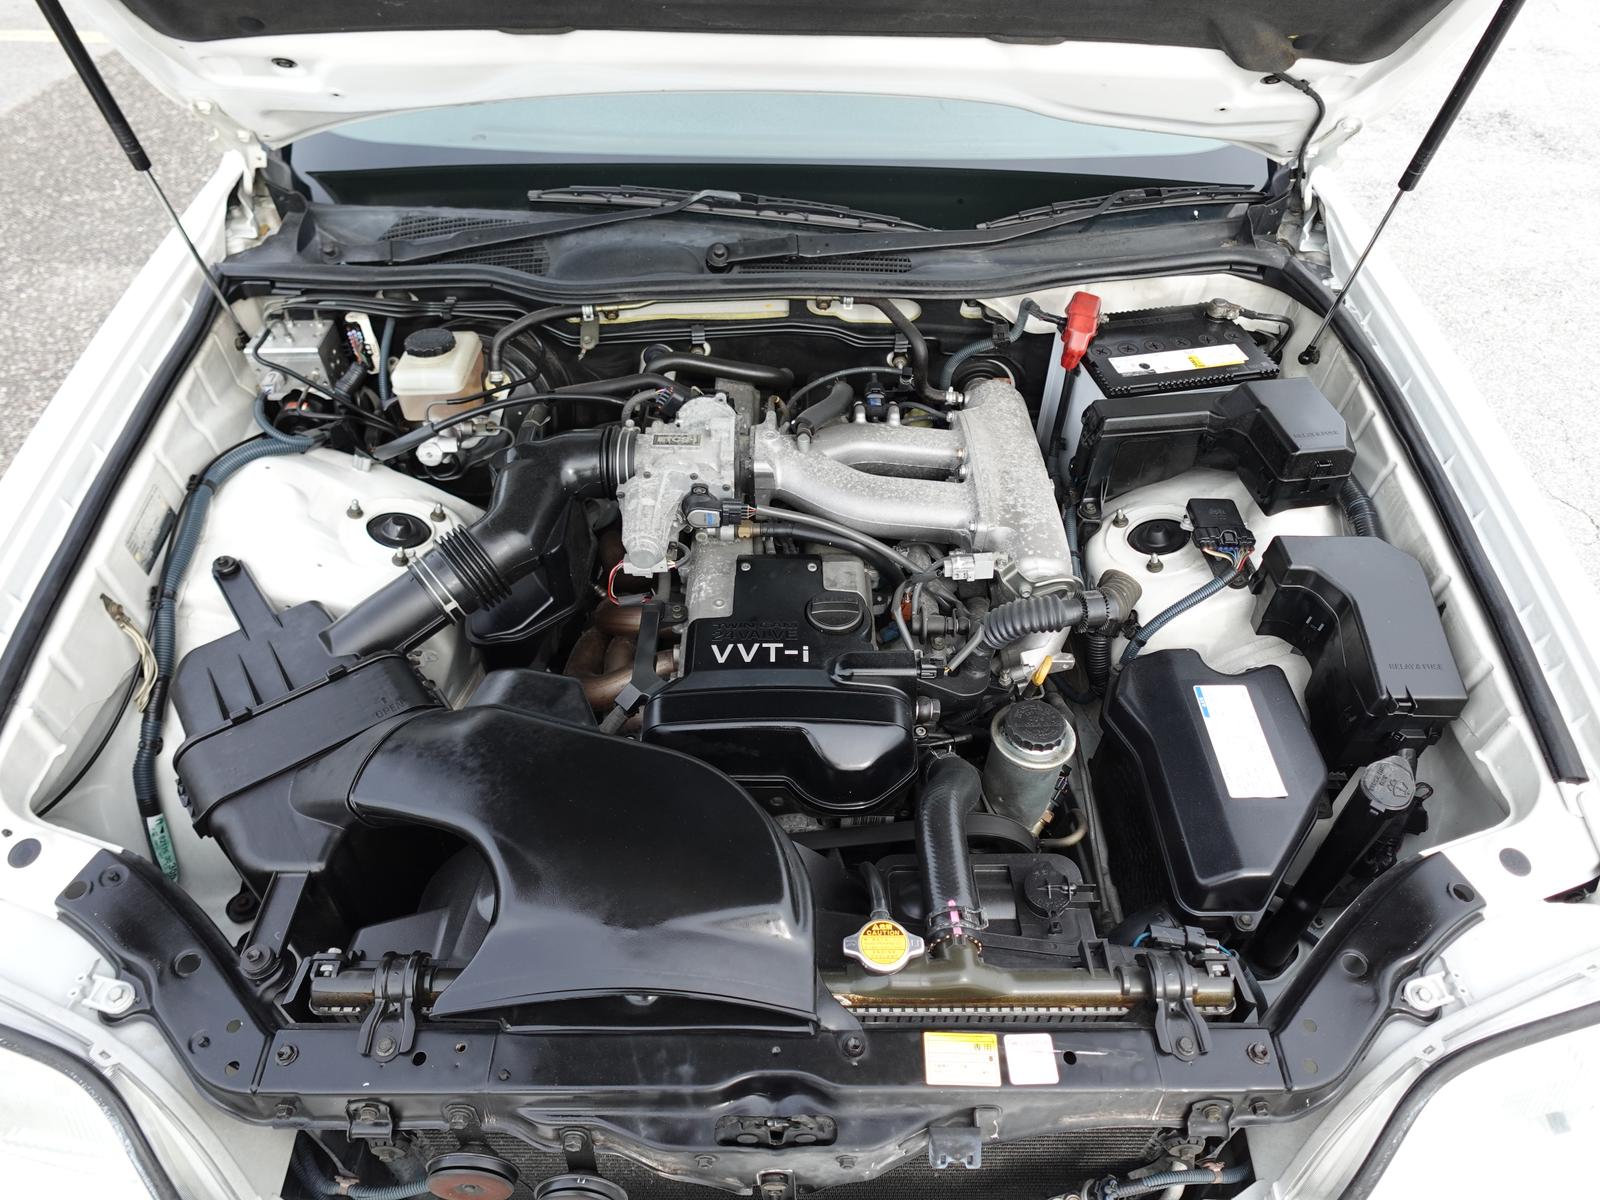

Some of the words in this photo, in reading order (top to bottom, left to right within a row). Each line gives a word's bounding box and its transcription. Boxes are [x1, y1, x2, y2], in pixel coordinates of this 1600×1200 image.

[711, 630, 736, 642] 24
[737, 630, 798, 641] VALVE
[711, 643, 809, 663] VVT-i
[375, 697, 408, 719] OPEN
